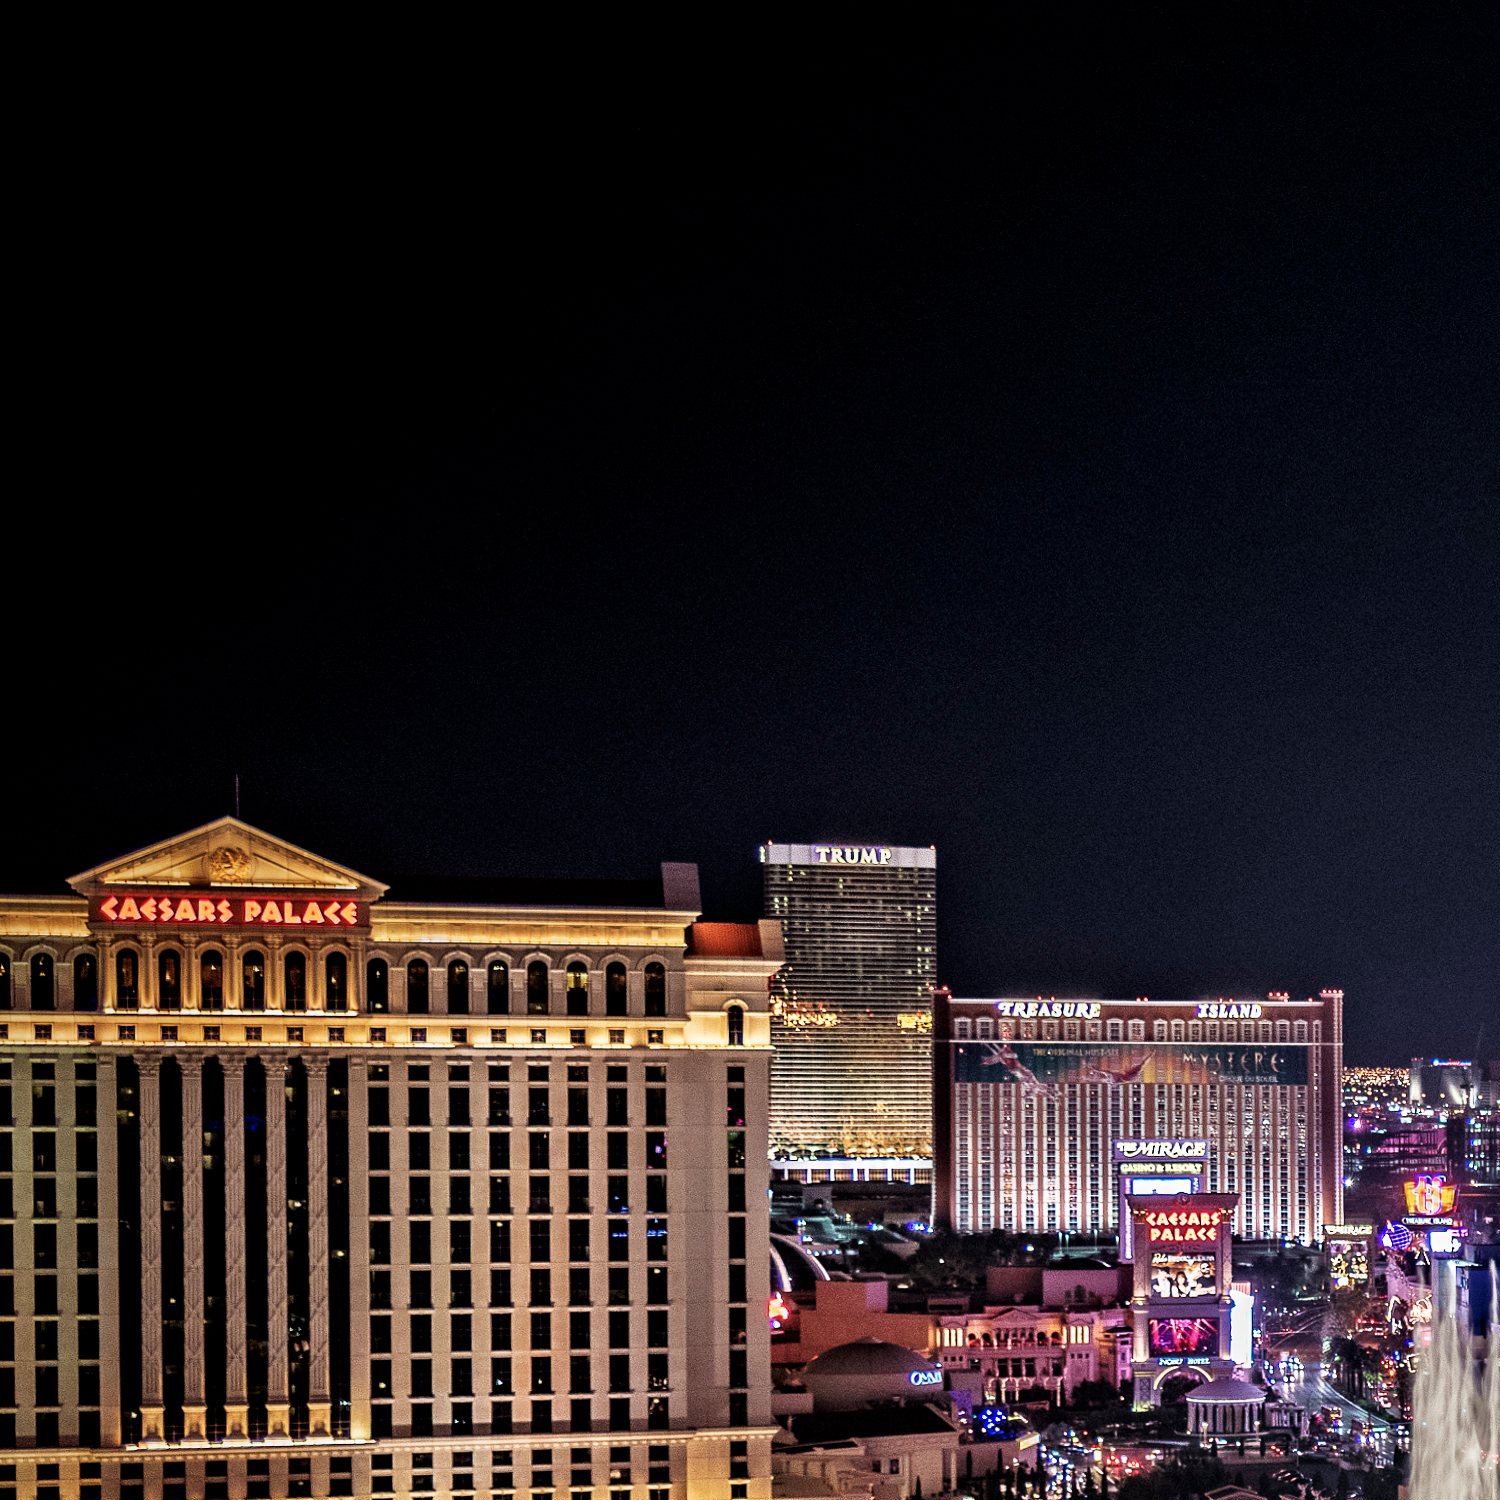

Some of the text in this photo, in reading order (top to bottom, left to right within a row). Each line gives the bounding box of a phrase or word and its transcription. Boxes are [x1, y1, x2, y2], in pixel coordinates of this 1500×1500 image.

[815, 847, 891, 865] TRUMP
[101, 896, 358, 925] CAESARS PALACE
[998, 1001, 1263, 1019] TREASURE ISLAND
[1139, 1142, 1206, 1158] MIRAGE
[1120, 1163, 1155, 1173] CASINO
[1166, 1163, 1202, 1173] RESORT
[1146, 1211, 1220, 1226] CAESARS
[1150, 1227, 1217, 1241] PALACE
